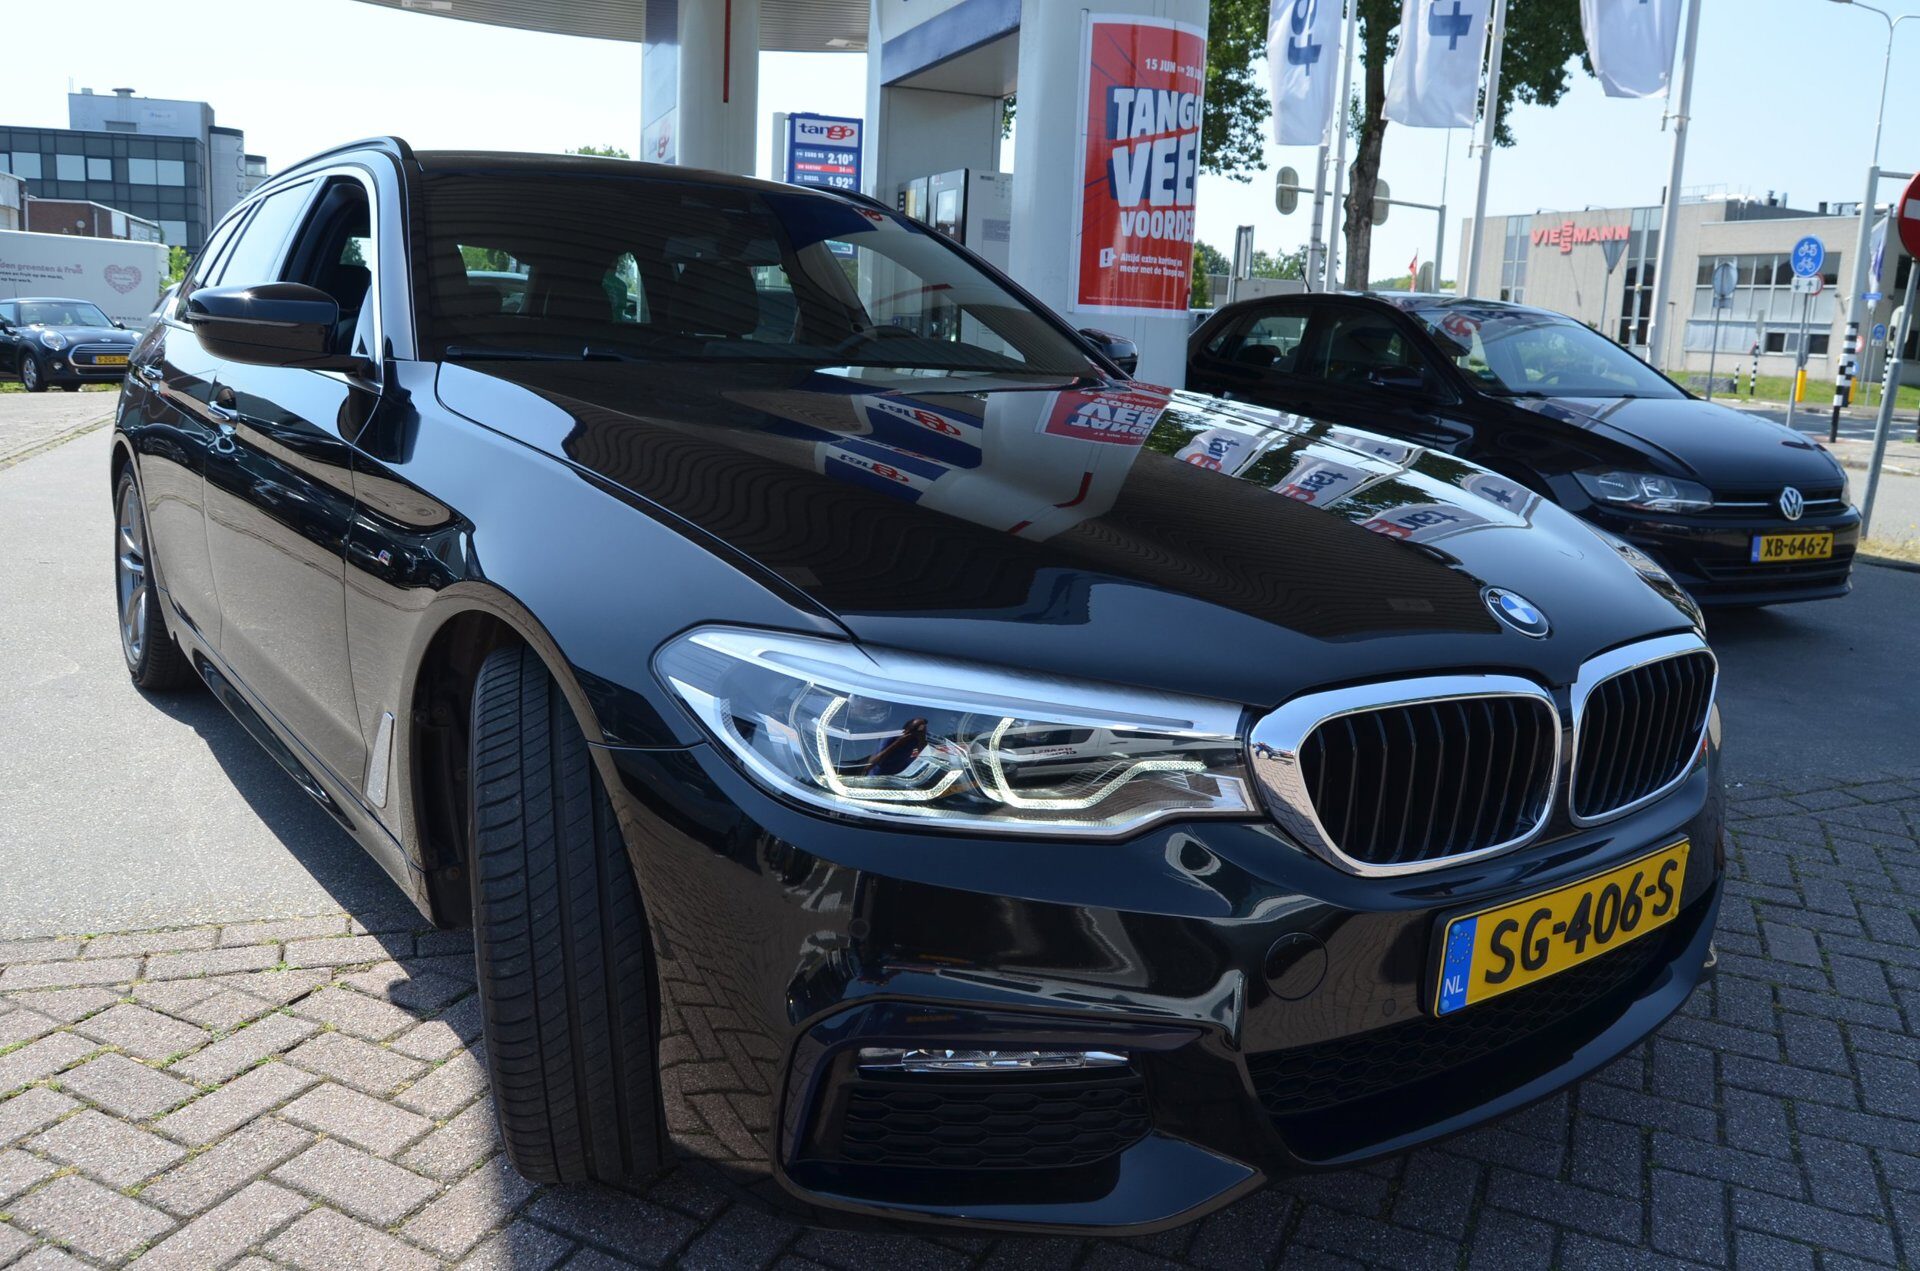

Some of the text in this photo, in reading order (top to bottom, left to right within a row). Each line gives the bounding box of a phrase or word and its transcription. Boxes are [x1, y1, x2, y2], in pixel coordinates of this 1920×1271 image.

[1145, 58, 1158, 71] 15
[1160, 60, 1176, 73] JUN
[799, 123, 855, 141] tango
[1112, 132, 1196, 208] VEE
[1120, 252, 1140, 263] Altijd
[1141, 254, 1157, 264] extra
[17, 263, 56, 273] groenten
[1119, 265, 1139, 273] meer
[1140, 266, 1153, 275] met
[1154, 266, 1162, 276] de
[1764, 536, 1830, 558] XB-646-Z
[1484, 858, 1679, 985] SG-406-S
[1442, 974, 1464, 998] NL
